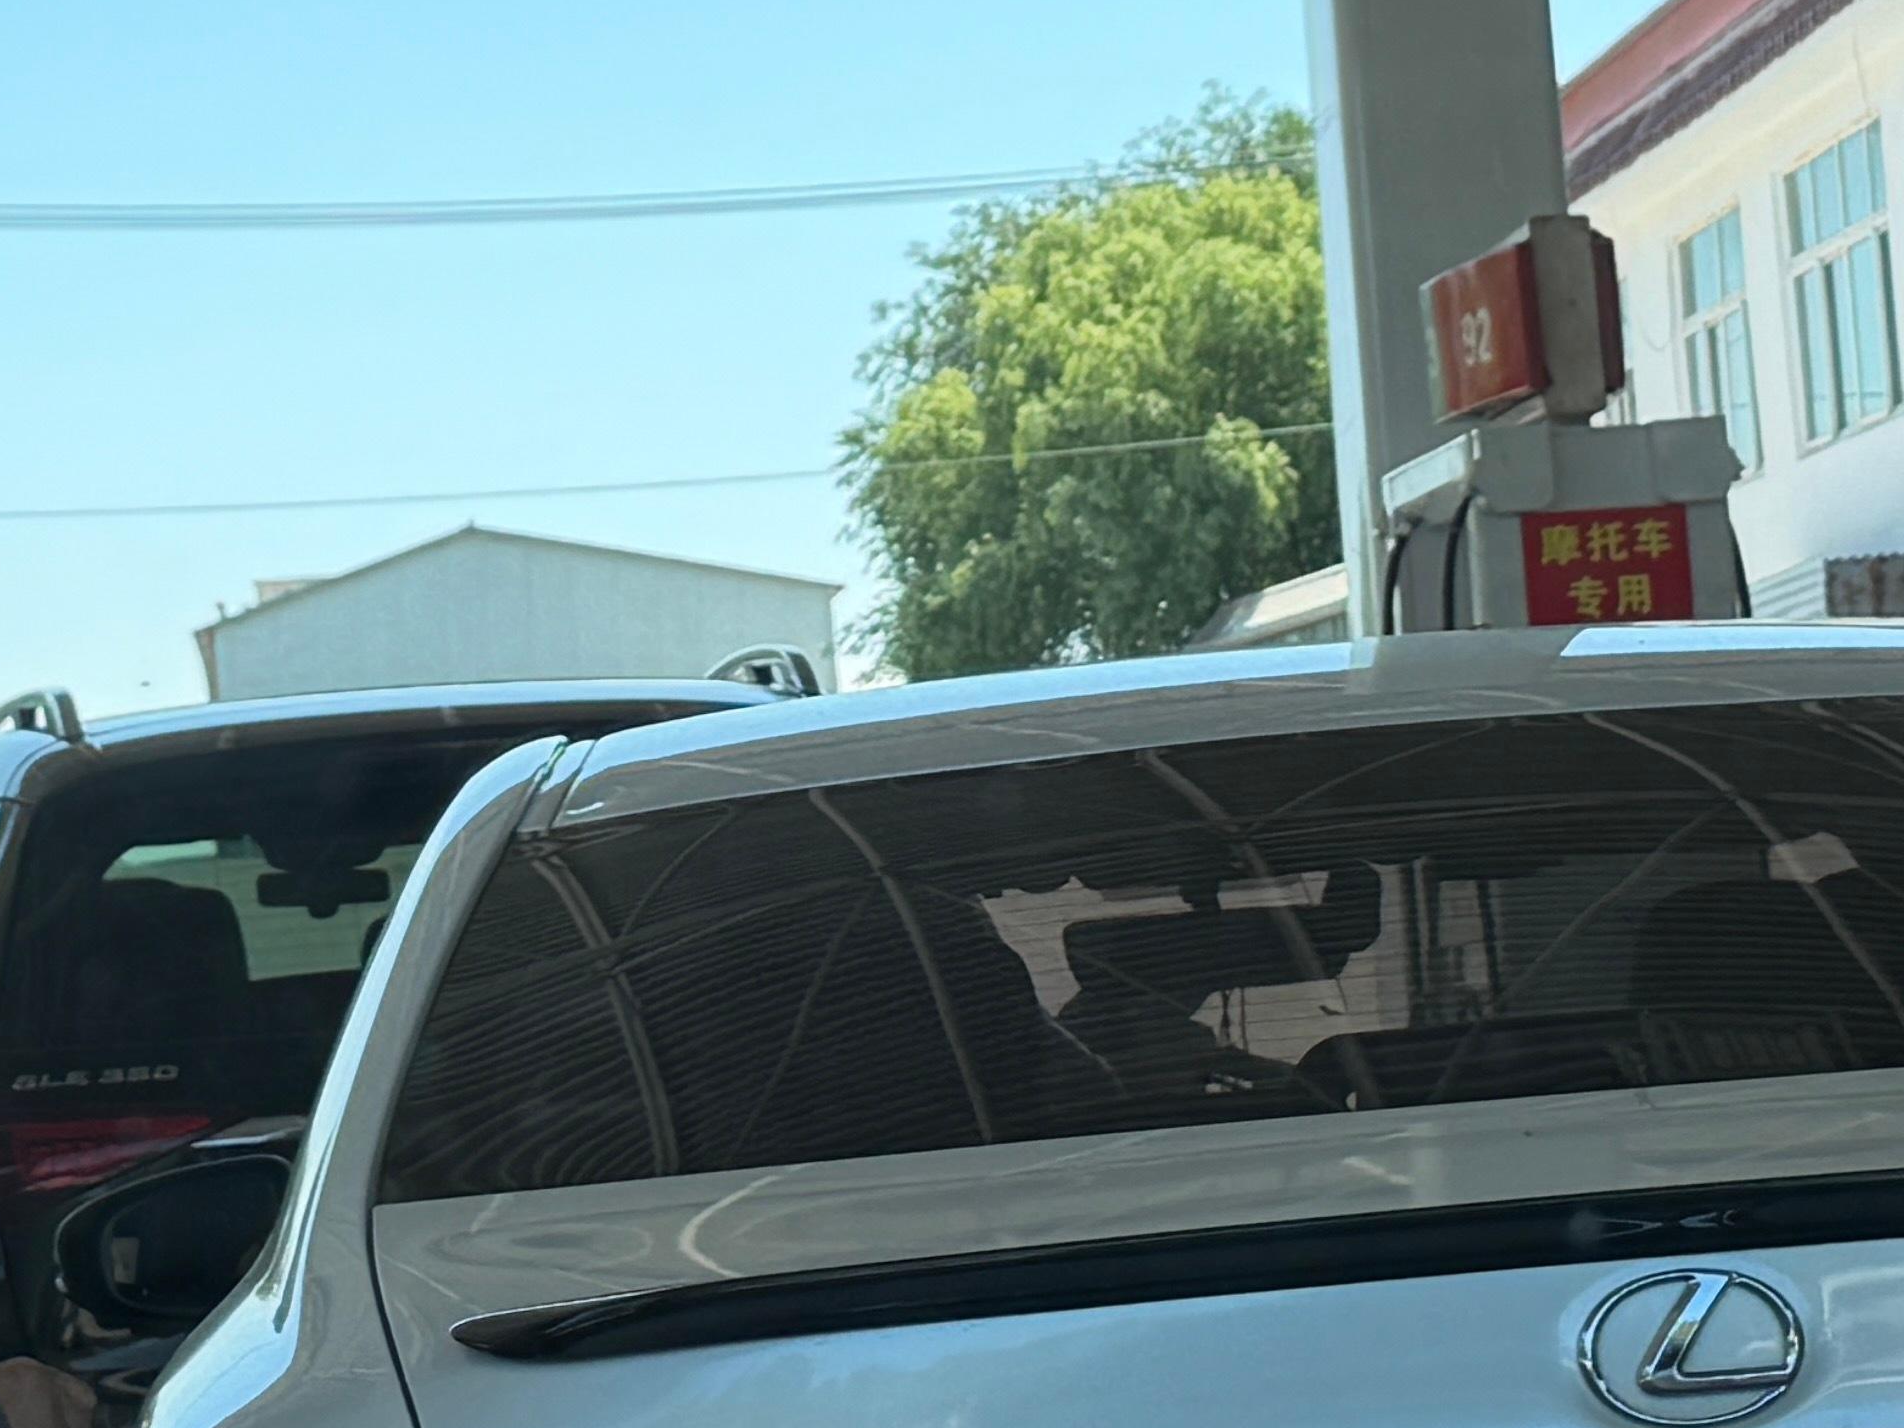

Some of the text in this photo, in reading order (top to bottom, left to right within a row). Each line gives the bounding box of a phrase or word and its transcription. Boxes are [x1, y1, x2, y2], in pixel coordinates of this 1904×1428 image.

[1459, 307, 1493, 367] 92
[1540, 518, 1673, 566] 摩托车
[1567, 574, 1652, 618] 专用
